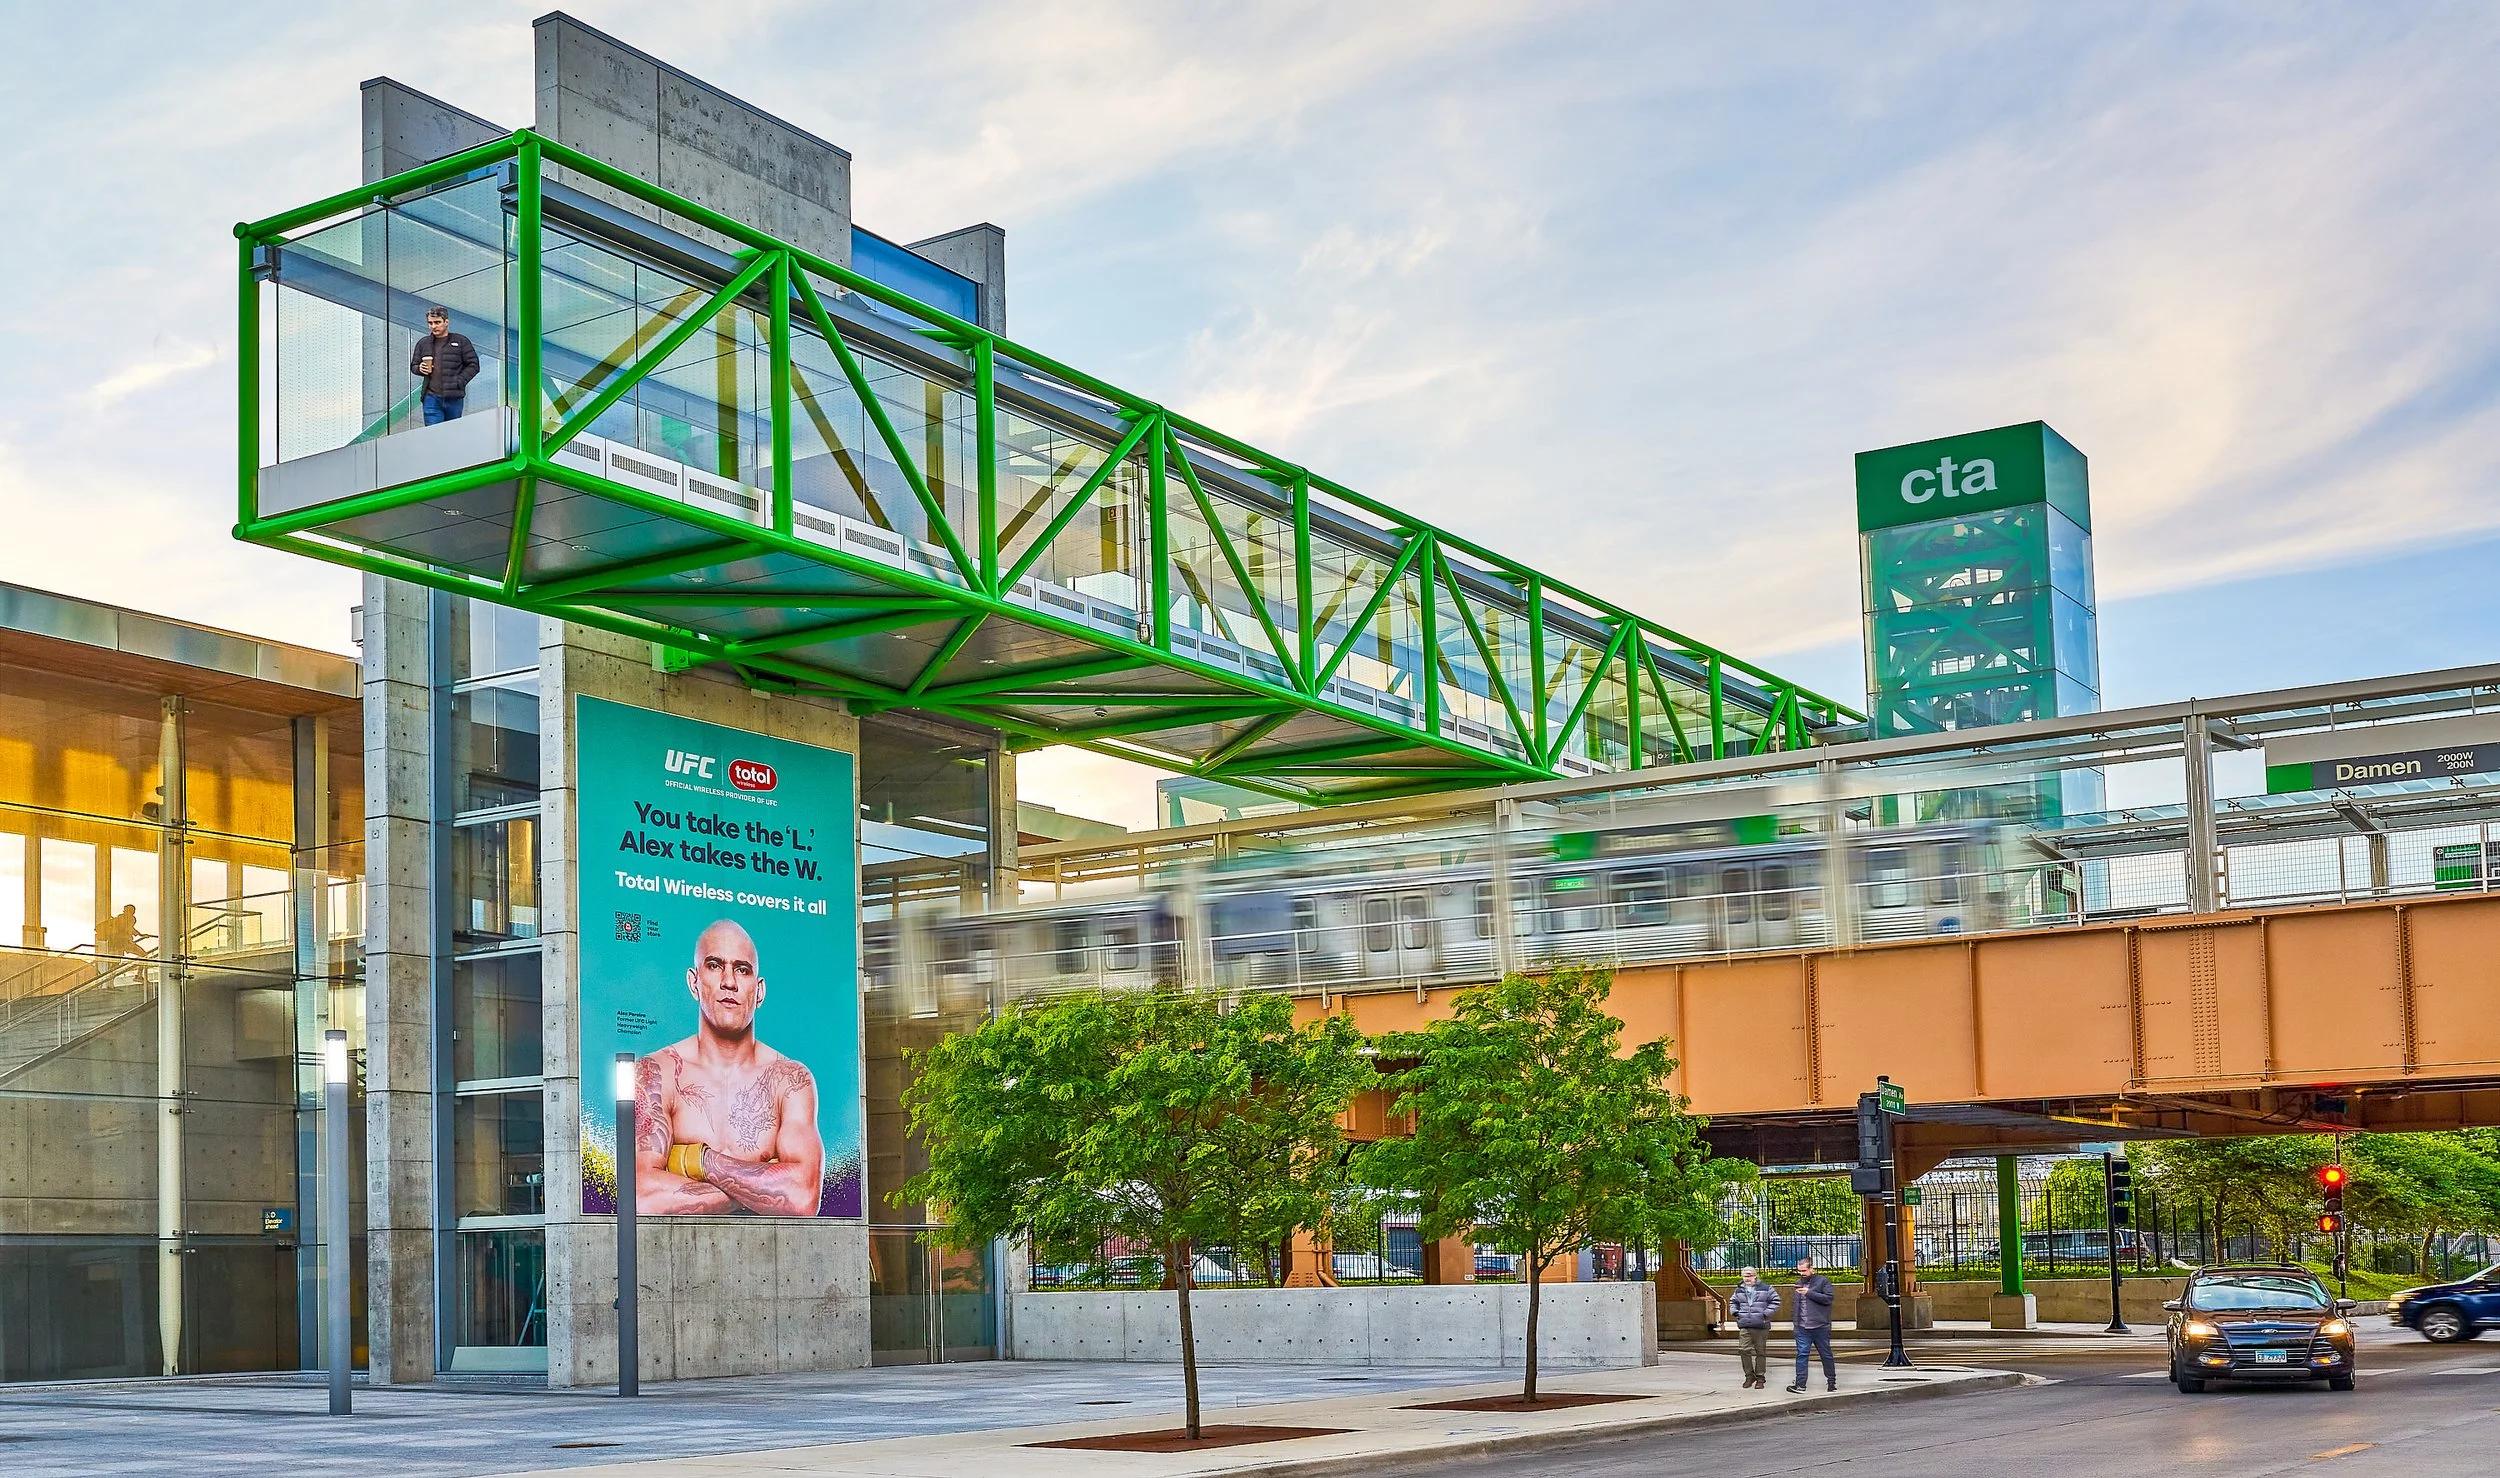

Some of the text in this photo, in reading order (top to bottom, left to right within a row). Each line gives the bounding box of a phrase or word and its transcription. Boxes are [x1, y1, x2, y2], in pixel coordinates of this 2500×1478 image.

[1901, 456, 1998, 504] cta
[665, 749, 716, 779] UFC
[2437, 751, 2474, 763] 2000W
[2446, 760, 2474, 770] 200N
[735, 765, 771, 785] total
[2336, 759, 2422, 781] Damen
[665, 779, 694, 791] OFFICIAL
[693, 785, 725, 797] WIRELESS
[725, 791, 756, 803] PROVIDER
[736, 780, 756, 788] wireless
[633, 801, 680, 830] You
[686, 811, 740, 840] take
[745, 821, 784, 848] the
[619, 830, 823, 882] Alex takes the W.
[615, 871, 827, 916] Total Wireless covers it all
